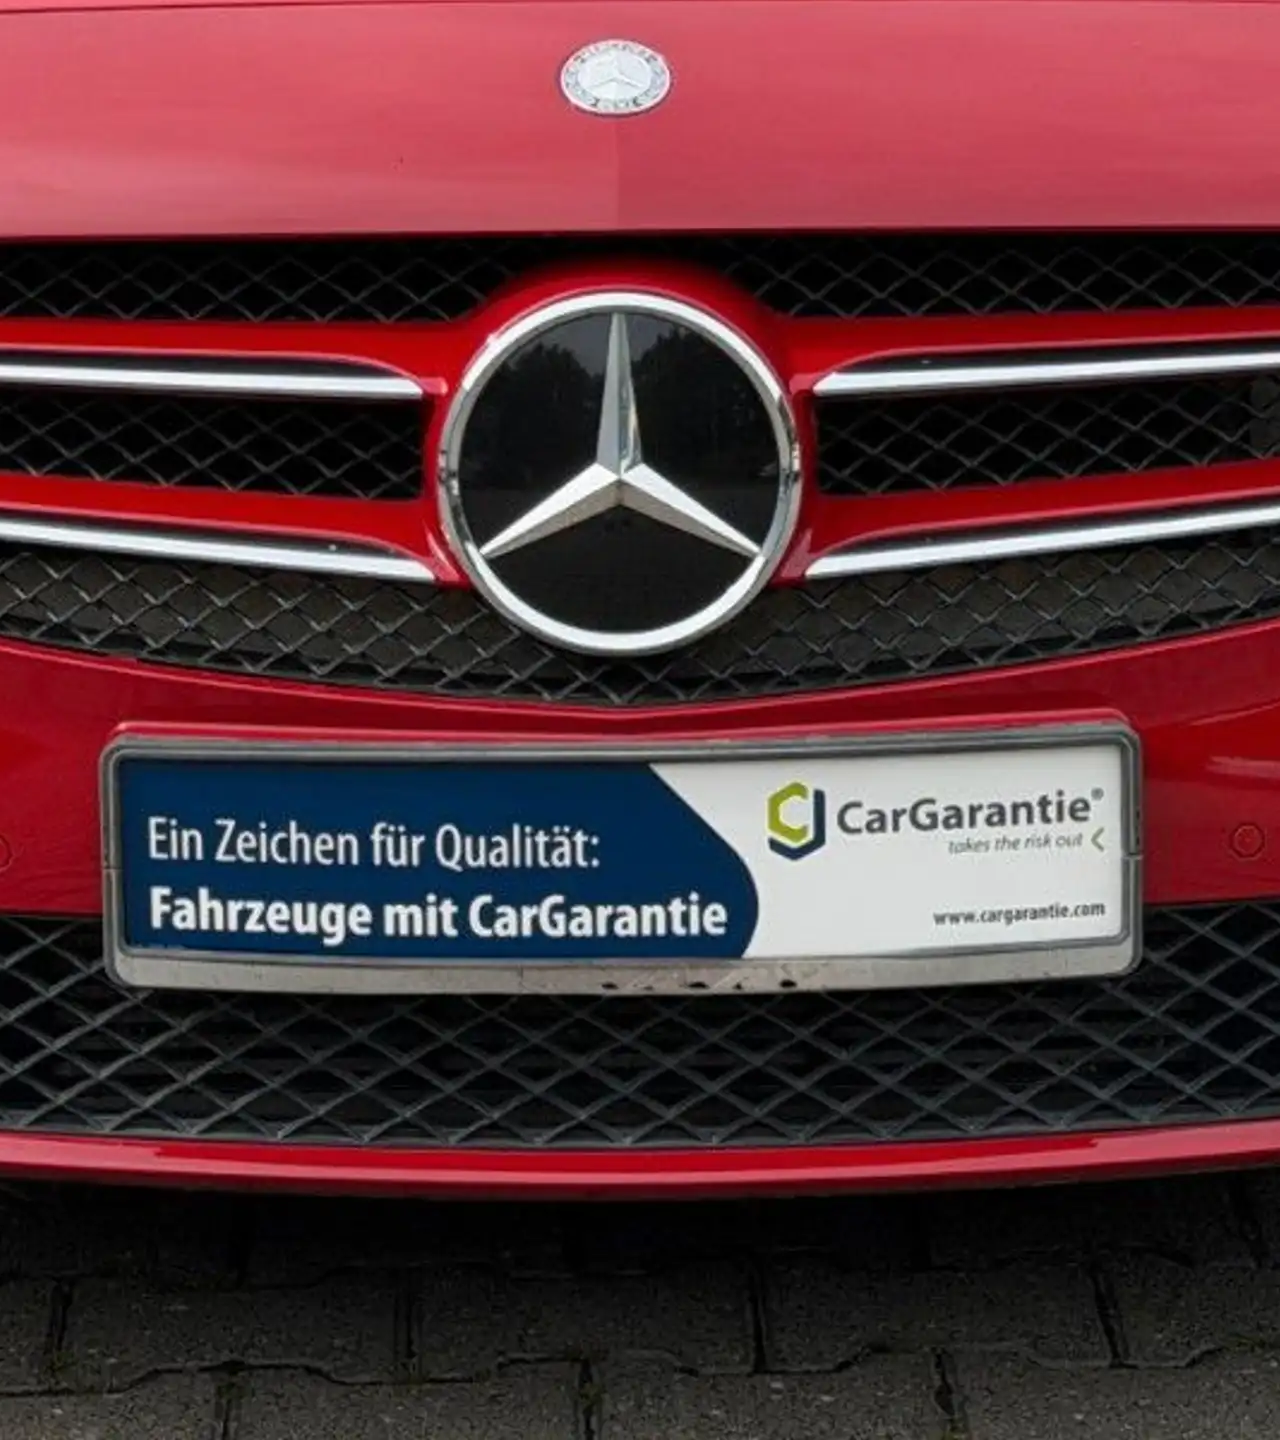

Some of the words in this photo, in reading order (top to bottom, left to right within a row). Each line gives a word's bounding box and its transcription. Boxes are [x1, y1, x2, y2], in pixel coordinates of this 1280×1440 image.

[148, 816, 203, 860] Ein
[215, 819, 359, 864] Zeichen
[371, 822, 425, 867] für
[436, 823, 600, 872] Qualität:
[948, 836, 990, 855] takes
[994, 833, 1021, 852] the
[1024, 832, 1053, 850] risk
[1055, 832, 1083, 848] out
[150, 886, 371, 946] Fahrzeuge
[383, 893, 458, 937] mit
[469, 891, 728, 938] CarGarantie
[933, 902, 1105, 926] www.cargarantie.com
